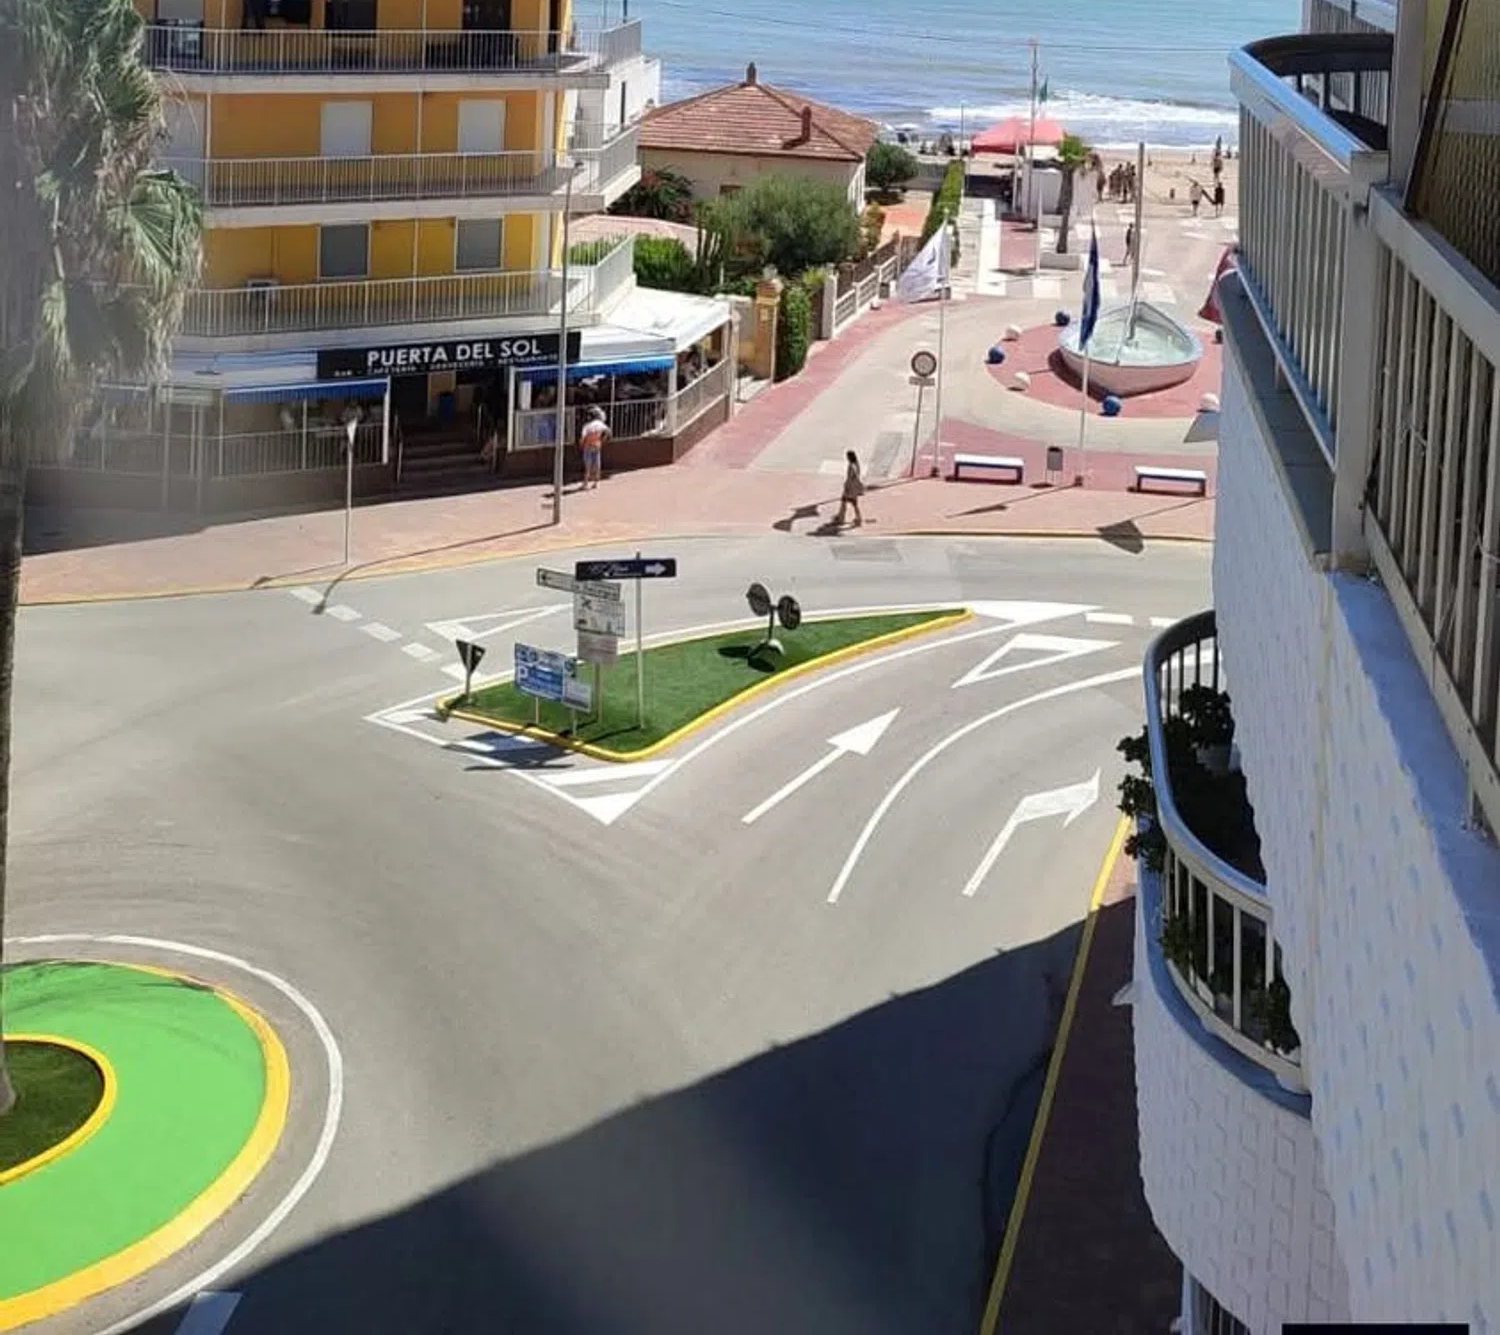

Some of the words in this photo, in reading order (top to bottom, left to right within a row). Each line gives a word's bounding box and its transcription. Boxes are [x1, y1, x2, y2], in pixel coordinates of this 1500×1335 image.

[367, 346, 448, 367] PUERTA
[456, 343, 494, 360] DEL
[500, 339, 541, 357] SOL
